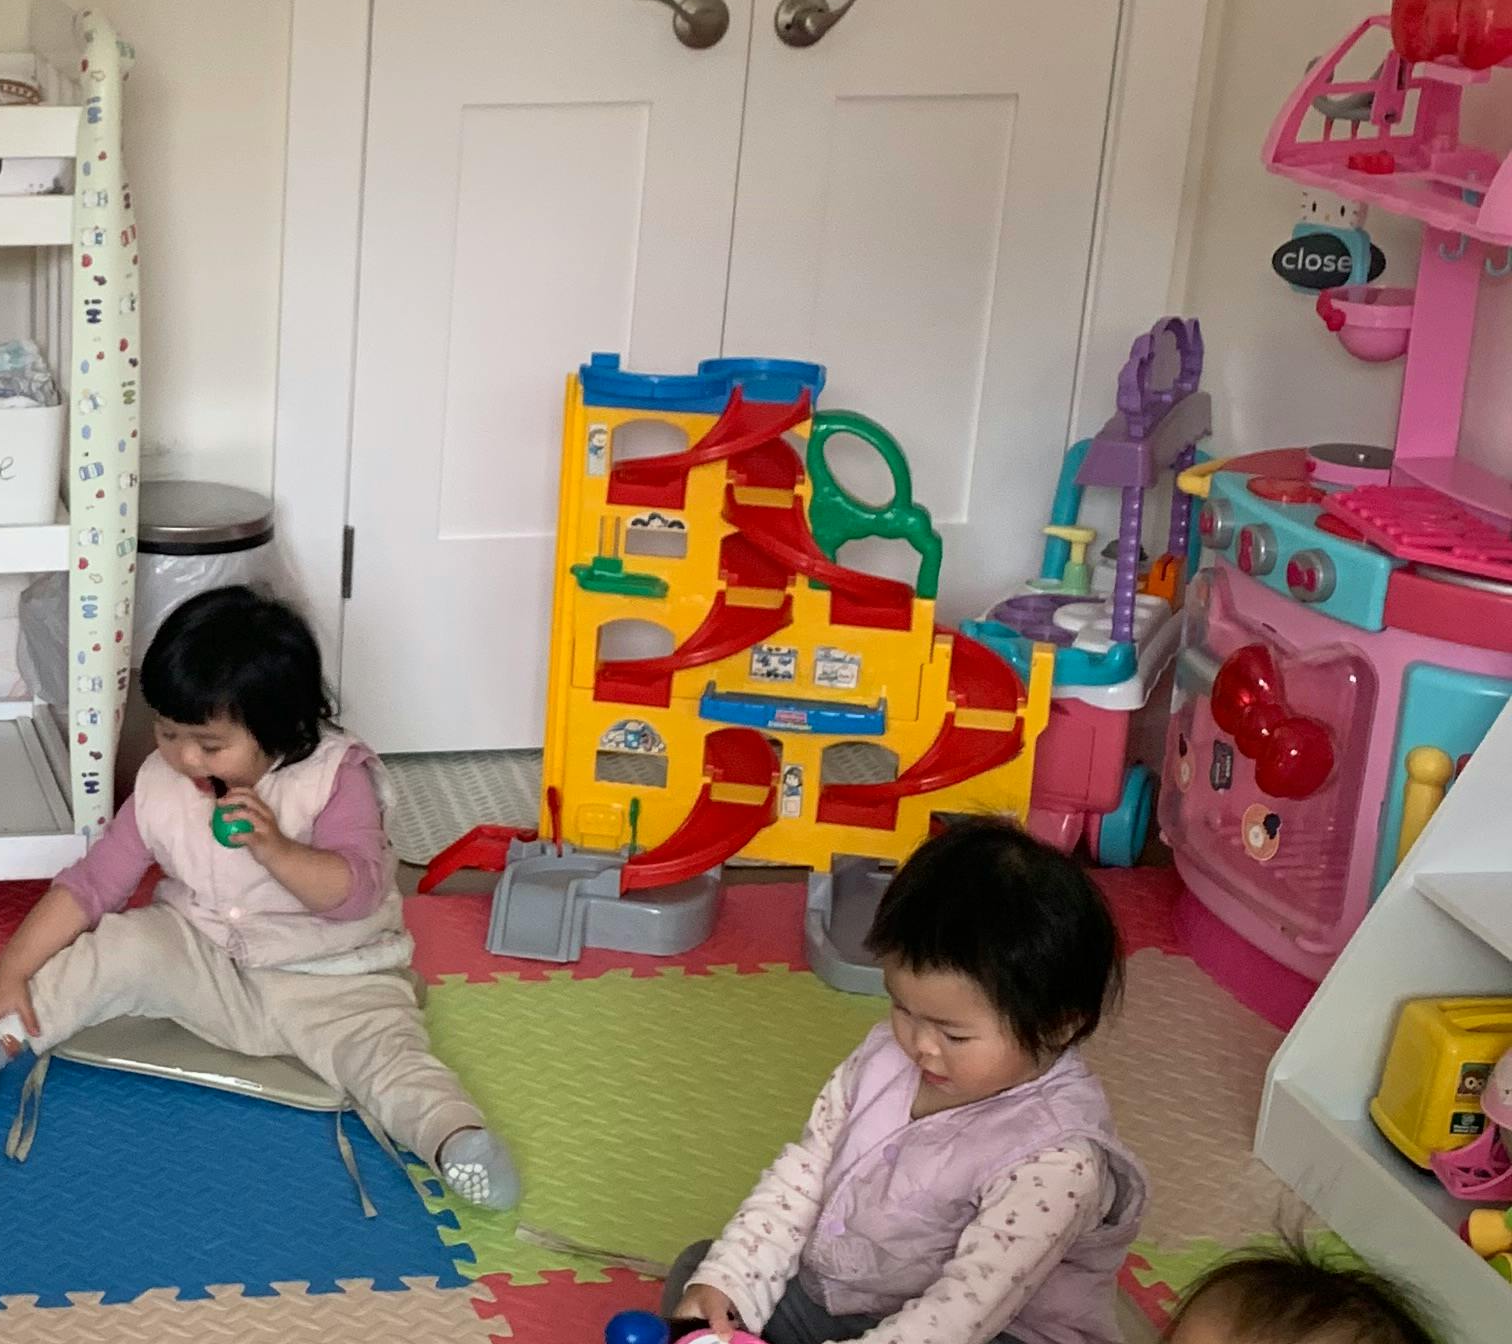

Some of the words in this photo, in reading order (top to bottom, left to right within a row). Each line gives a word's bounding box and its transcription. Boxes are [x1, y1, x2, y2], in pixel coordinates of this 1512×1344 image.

[86, 96, 102, 124] Hi
[1281, 247, 1352, 273] close
[84, 298, 102, 324] Hi
[121, 380, 136, 405] Hi
[80, 594, 98, 619] Hi
[82, 771, 100, 795] Hi
